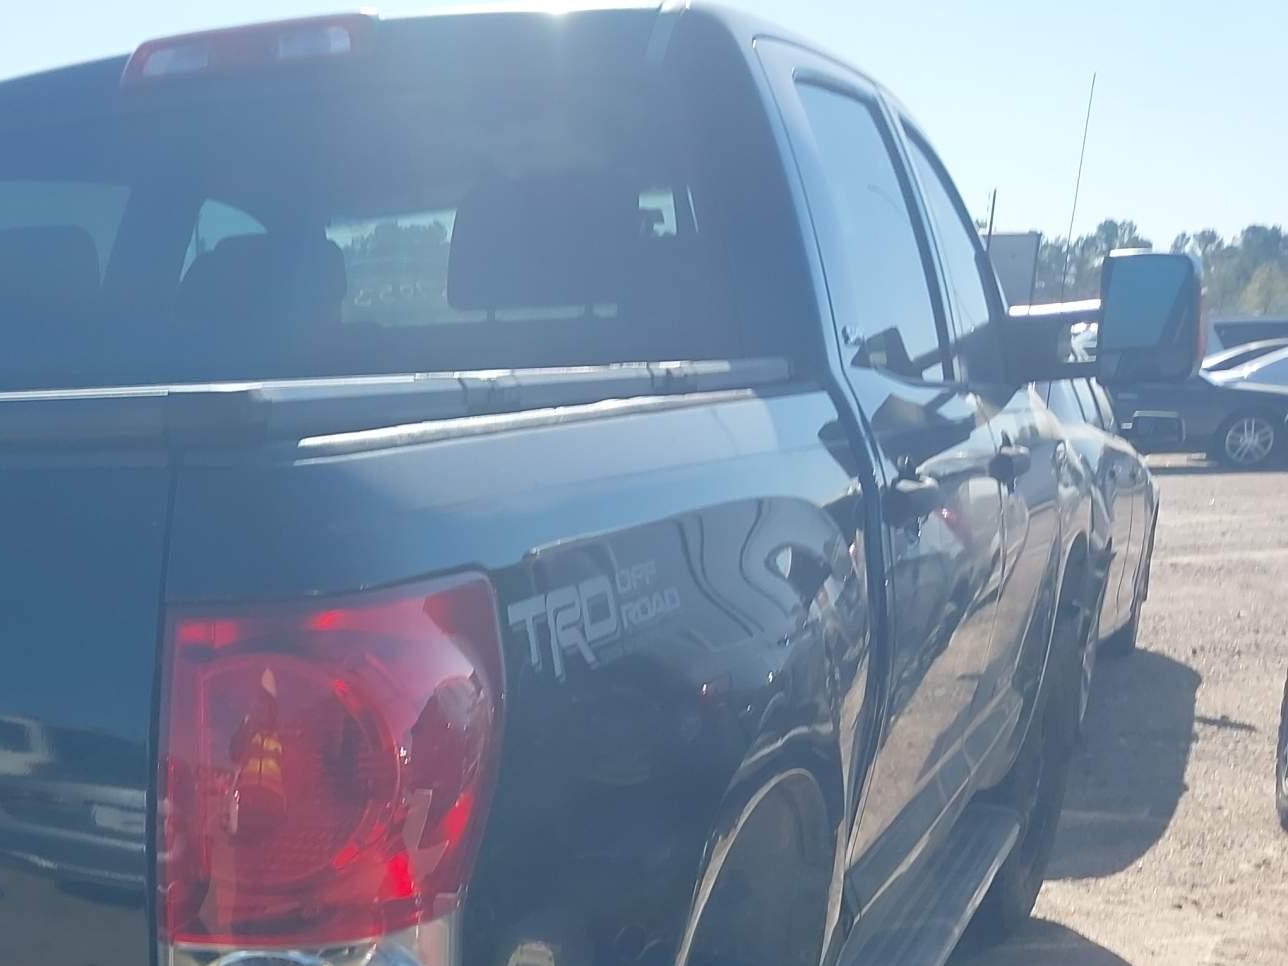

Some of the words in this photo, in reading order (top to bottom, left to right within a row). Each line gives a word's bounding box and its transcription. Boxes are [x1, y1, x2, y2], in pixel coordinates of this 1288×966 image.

[617, 560, 658, 595] OFF
[508, 574, 620, 683] TRD
[621, 586, 681, 630] ROAD
